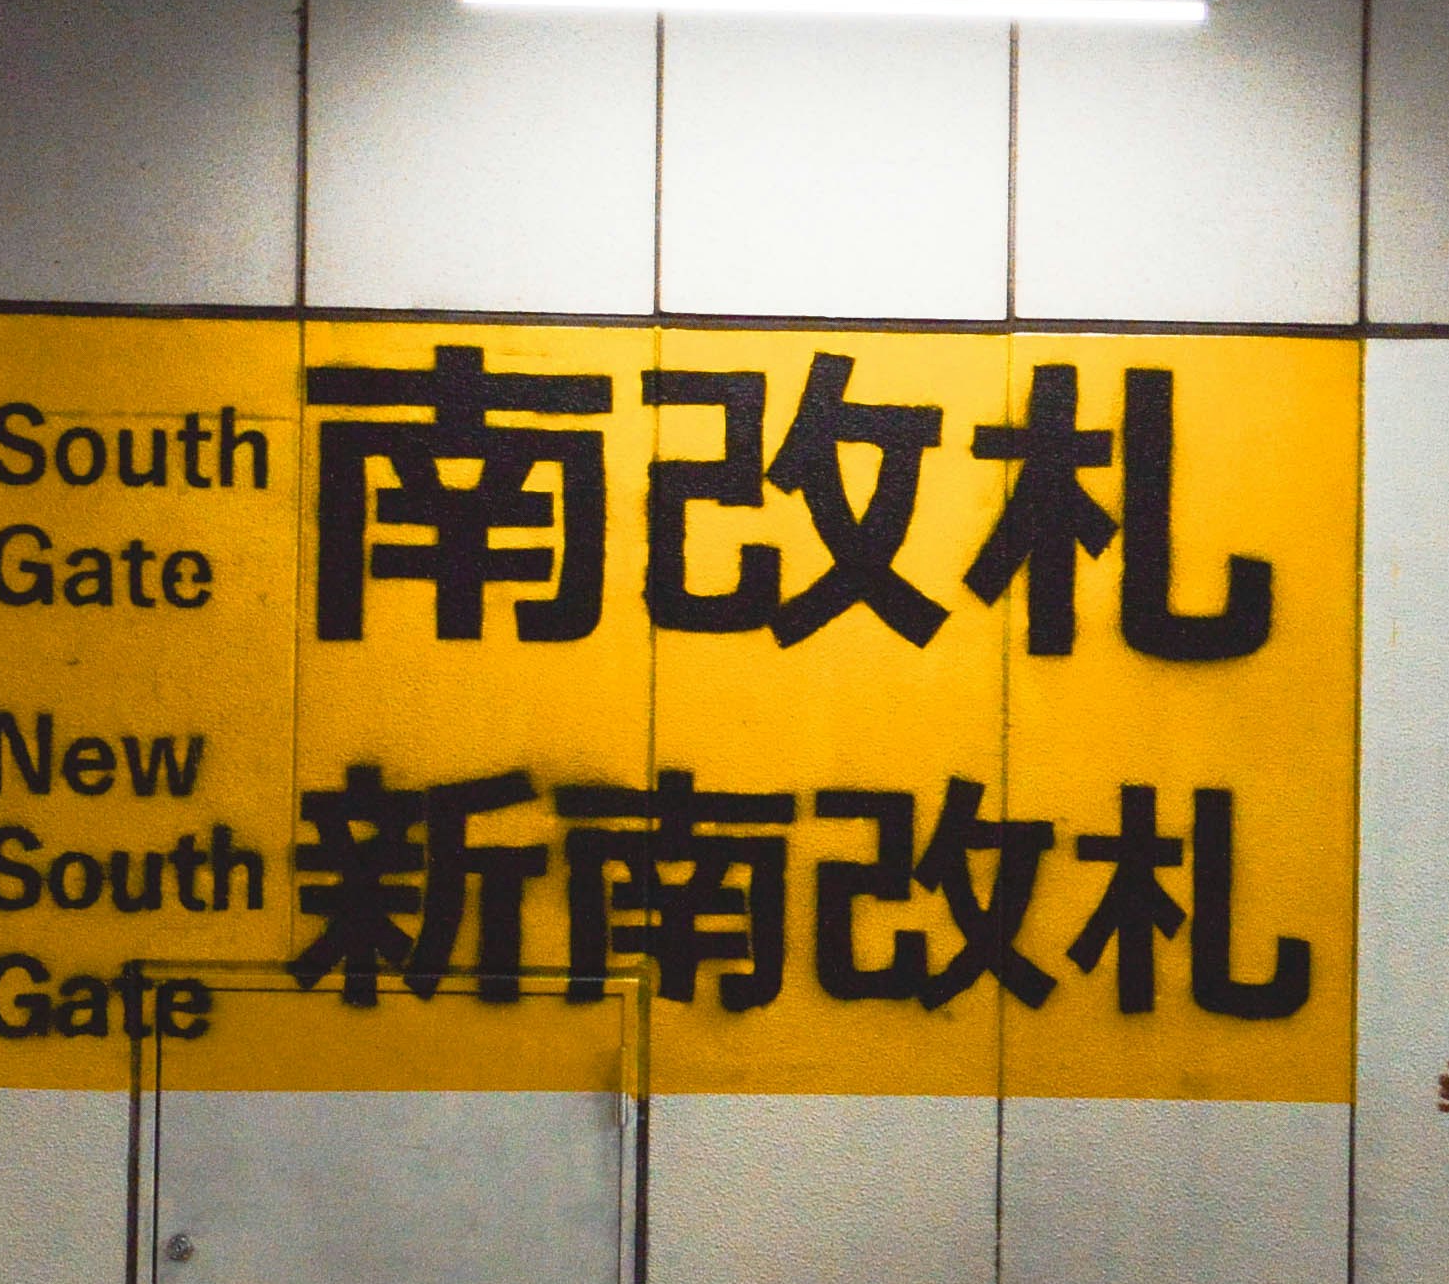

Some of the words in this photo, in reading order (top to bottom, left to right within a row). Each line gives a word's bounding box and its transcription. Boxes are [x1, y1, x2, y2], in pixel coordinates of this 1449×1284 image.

[306, 346, 1274, 663] 南改札
[286, 763, 1311, 1021] 新南改札
